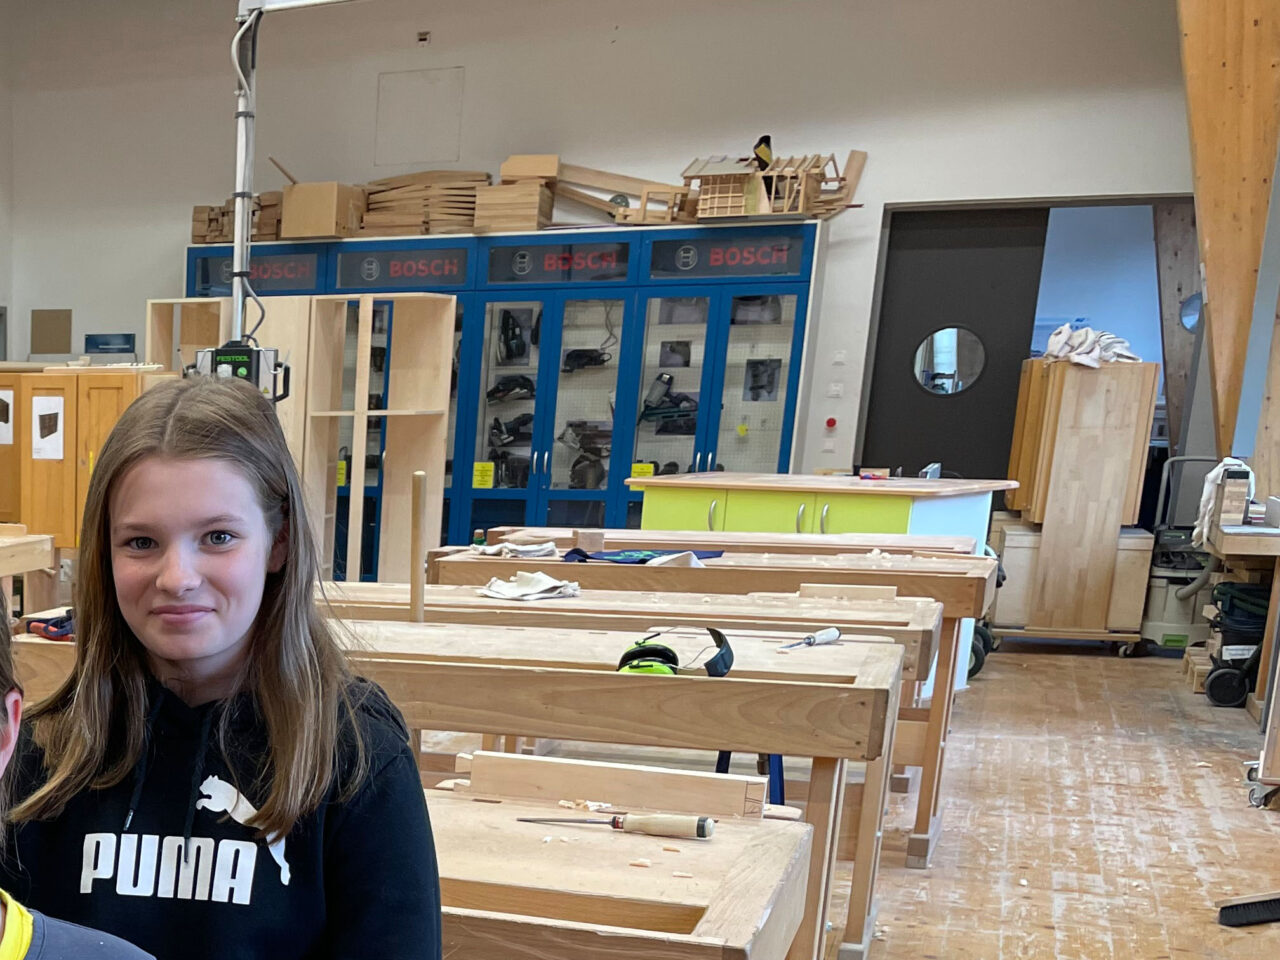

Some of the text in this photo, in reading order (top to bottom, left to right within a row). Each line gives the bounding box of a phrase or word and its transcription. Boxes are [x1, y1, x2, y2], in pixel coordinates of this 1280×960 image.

[543, 251, 617, 272] BOSCH
[708, 245, 788, 267] BOSCH
[248, 261, 311, 280] BOSCH
[388, 259, 458, 278] BOSCH
[79, 832, 259, 905] PUMA
